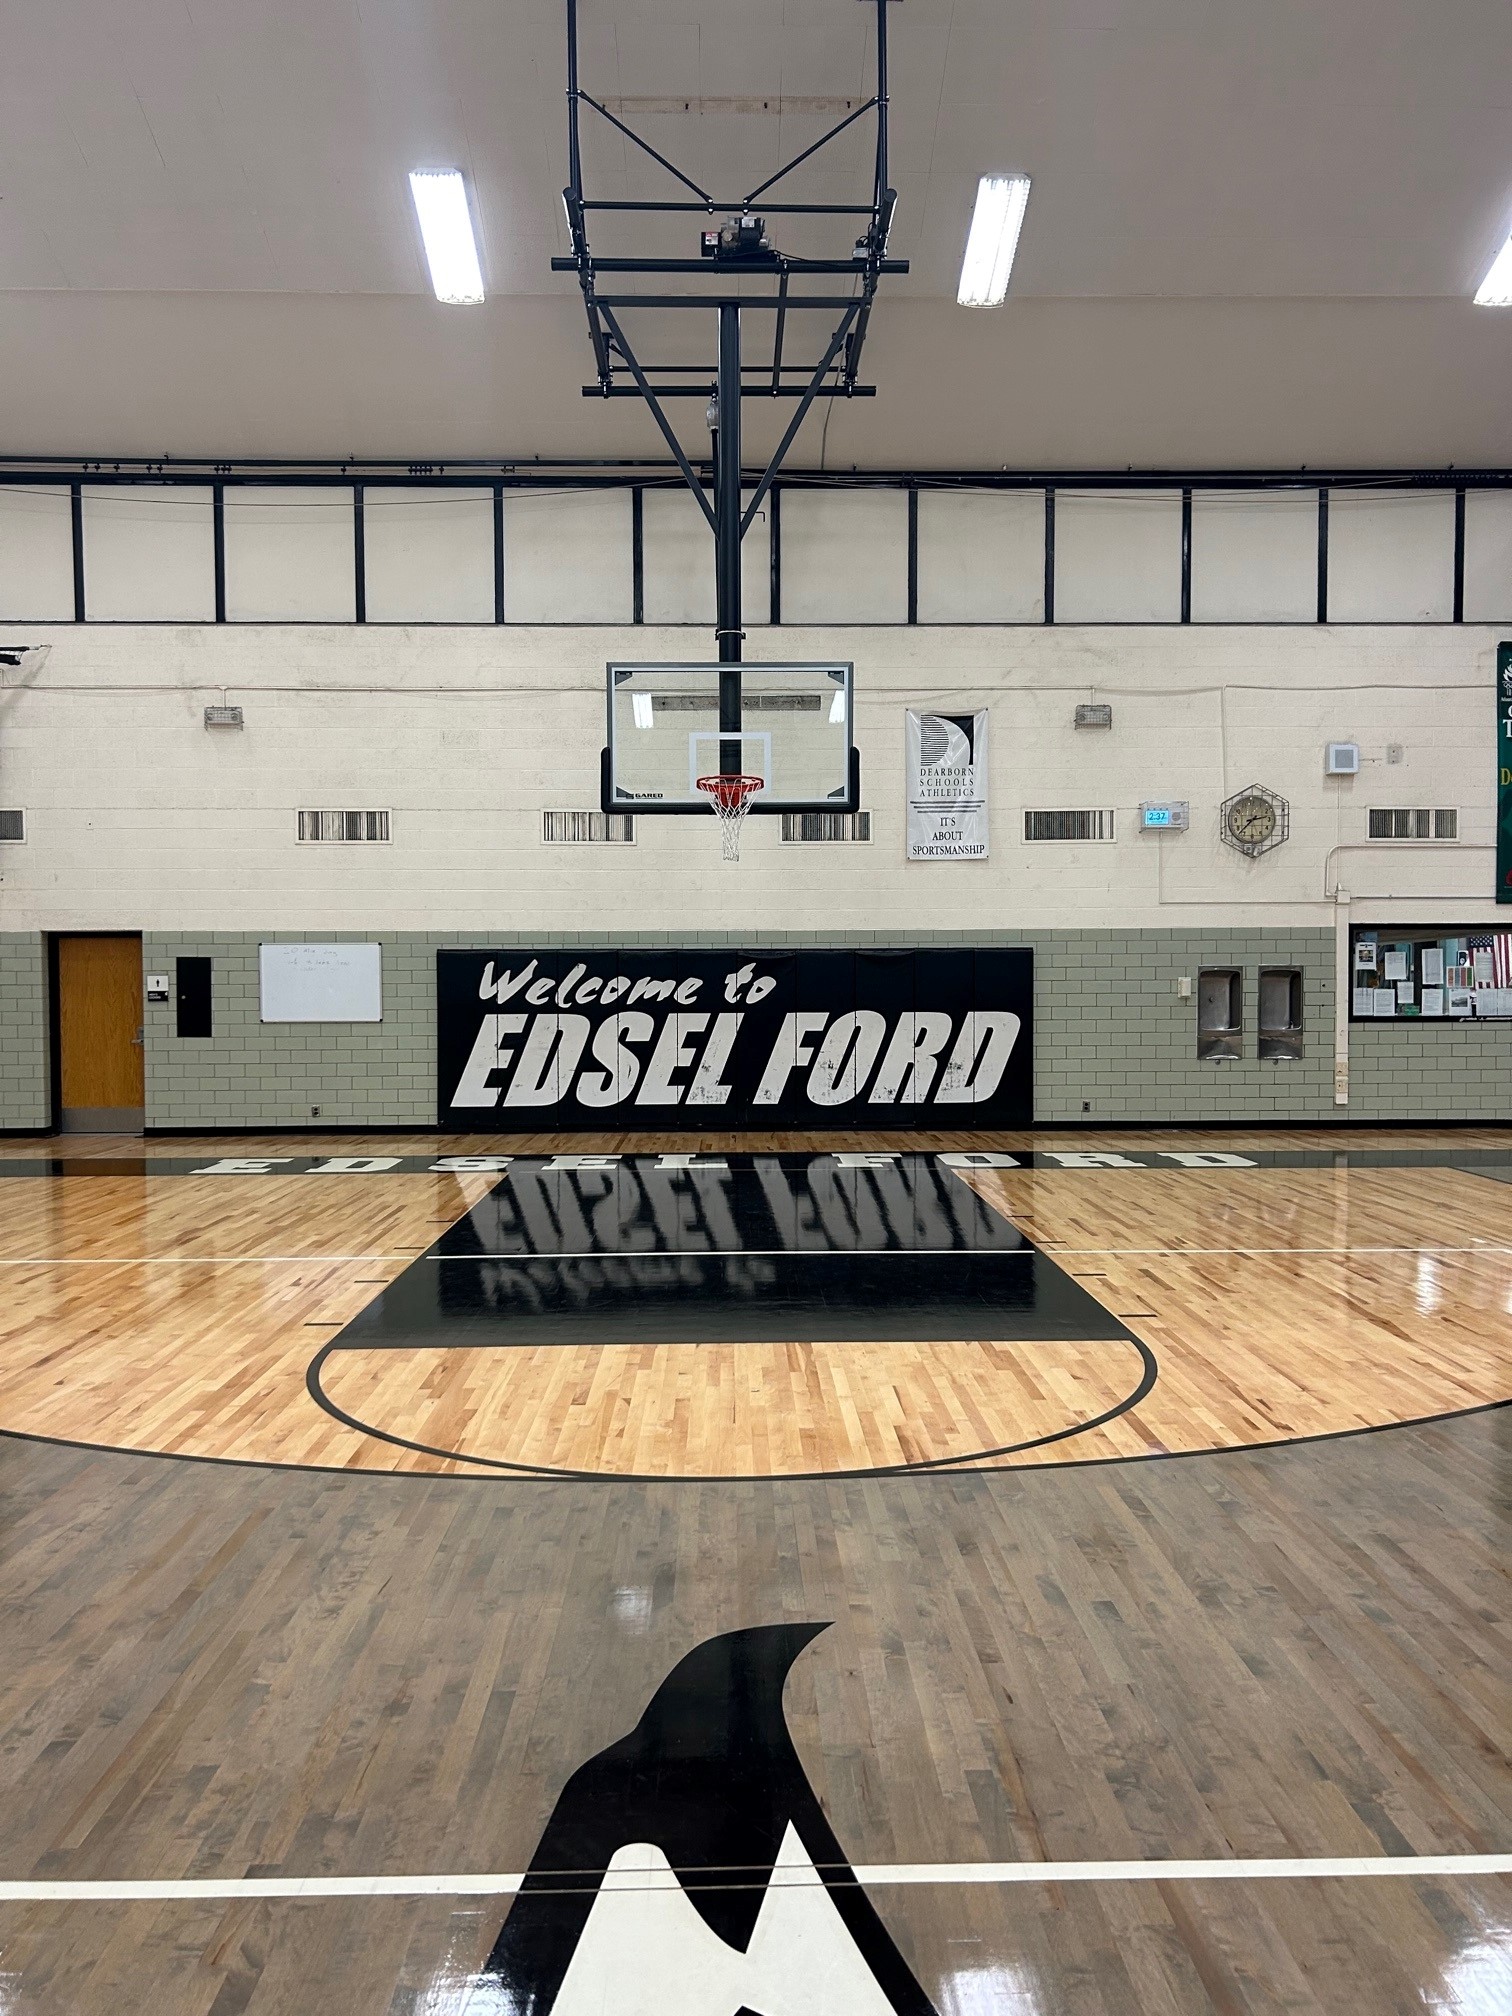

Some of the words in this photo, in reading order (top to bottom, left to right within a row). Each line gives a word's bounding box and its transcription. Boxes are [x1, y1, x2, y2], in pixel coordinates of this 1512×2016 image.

[920, 767, 974, 777] DEARBORN
[920, 778, 974, 787] SCHOOLS
[920, 788, 974, 797] ATHLETICS
[932, 831, 963, 841] ABOUT
[912, 844, 985, 856] SPORTSMANSHIP
[479, 959, 705, 1009] Welcome
[723, 962, 777, 1004] to
[450, 1011, 745, 1108] EDSEL
[752, 1010, 1021, 1106] FORD
[189, 1153, 729, 1174] EDSEL
[831, 1152, 1259, 1168] FORD
